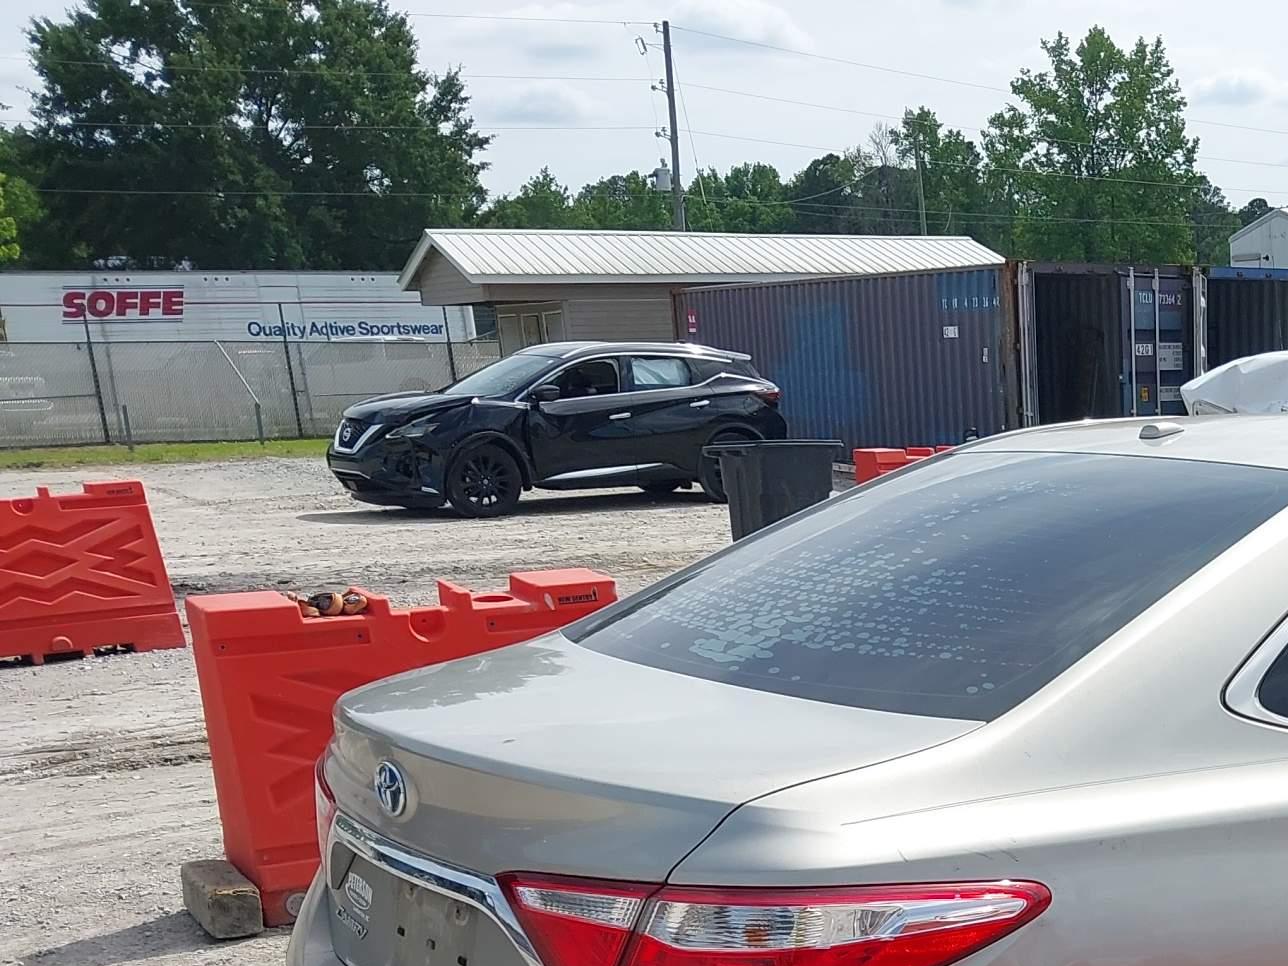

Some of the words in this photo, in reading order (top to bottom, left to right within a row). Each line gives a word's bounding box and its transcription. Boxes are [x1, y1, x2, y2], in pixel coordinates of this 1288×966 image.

[63, 291, 184, 318] SOFFE
[248, 322, 306, 339] Quality
[309, 322, 356, 337] Active
[359, 321, 444, 337] Sportswear
[347, 872, 374, 905] PETERSON
